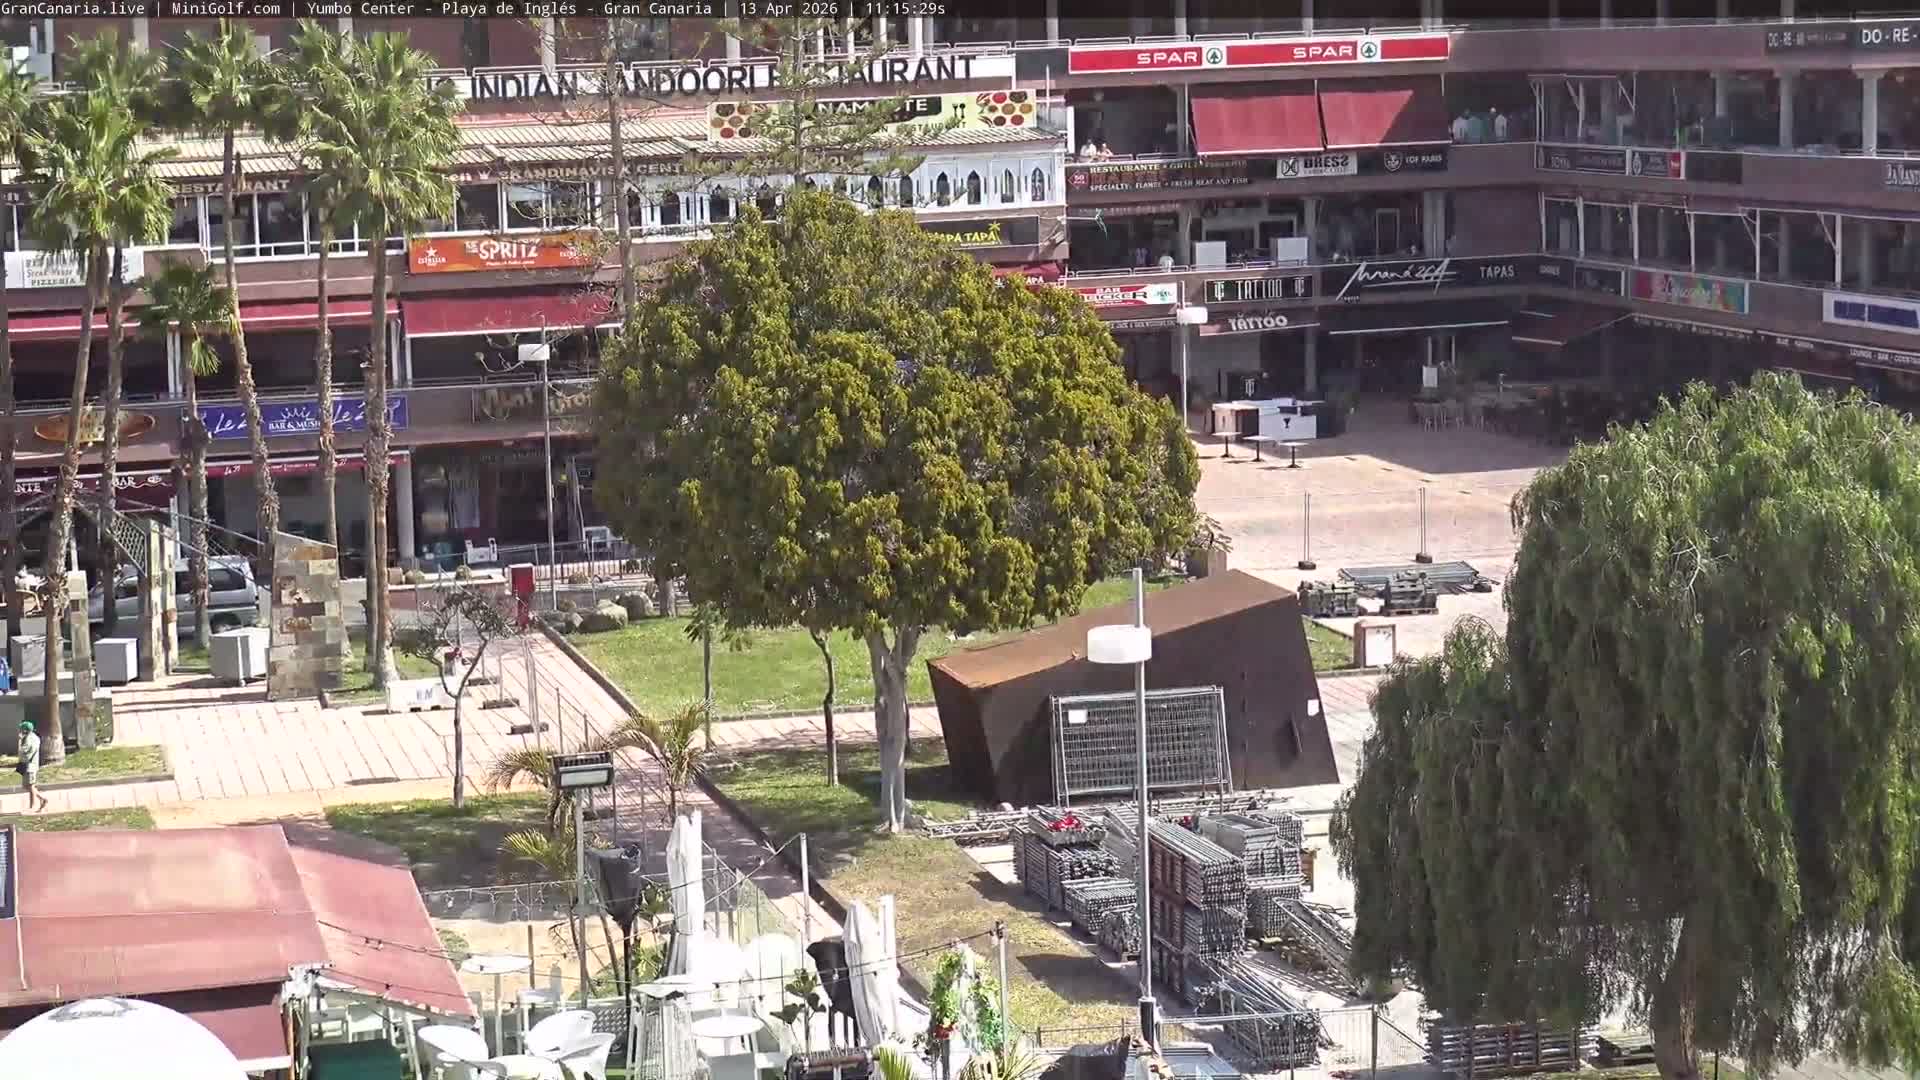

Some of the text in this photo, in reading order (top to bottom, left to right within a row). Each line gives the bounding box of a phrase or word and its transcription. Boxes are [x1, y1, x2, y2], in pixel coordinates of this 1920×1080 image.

[1862, 28, 1882, 44] DO
[1892, 27, 1910, 43] RE
[1137, 45, 1353, 65] SPAR SPAR
[471, 71, 577, 100] INDIAN
[1089, 163, 1161, 173] RESTAURANTE
[963, 231, 997, 242] TAPA
[479, 238, 540, 260] SPRITZ
[1480, 265, 1516, 280] TAPAS
[1235, 279, 1283, 300] TATTOO
[1227, 314, 1289, 331] TATTOO
[268, 421, 285, 431] BAR
[286, 420, 295, 430] &
